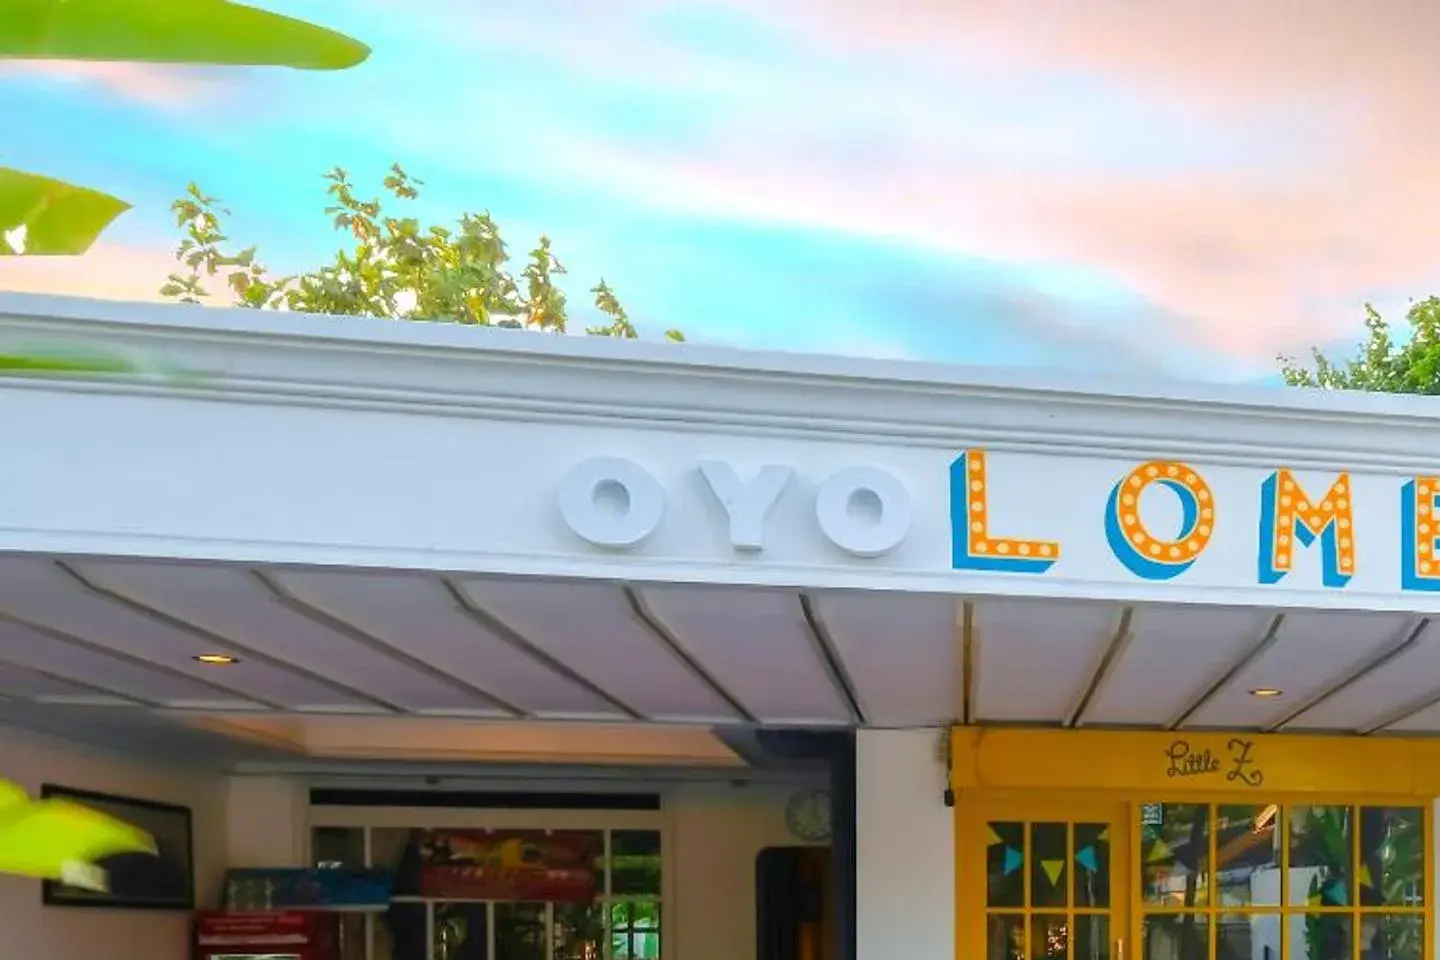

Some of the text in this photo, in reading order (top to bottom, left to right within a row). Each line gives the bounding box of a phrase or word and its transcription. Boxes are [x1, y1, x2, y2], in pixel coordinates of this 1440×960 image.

[555, 455, 913, 556] OYO
[1165, 738, 1263, 786] Little Z
